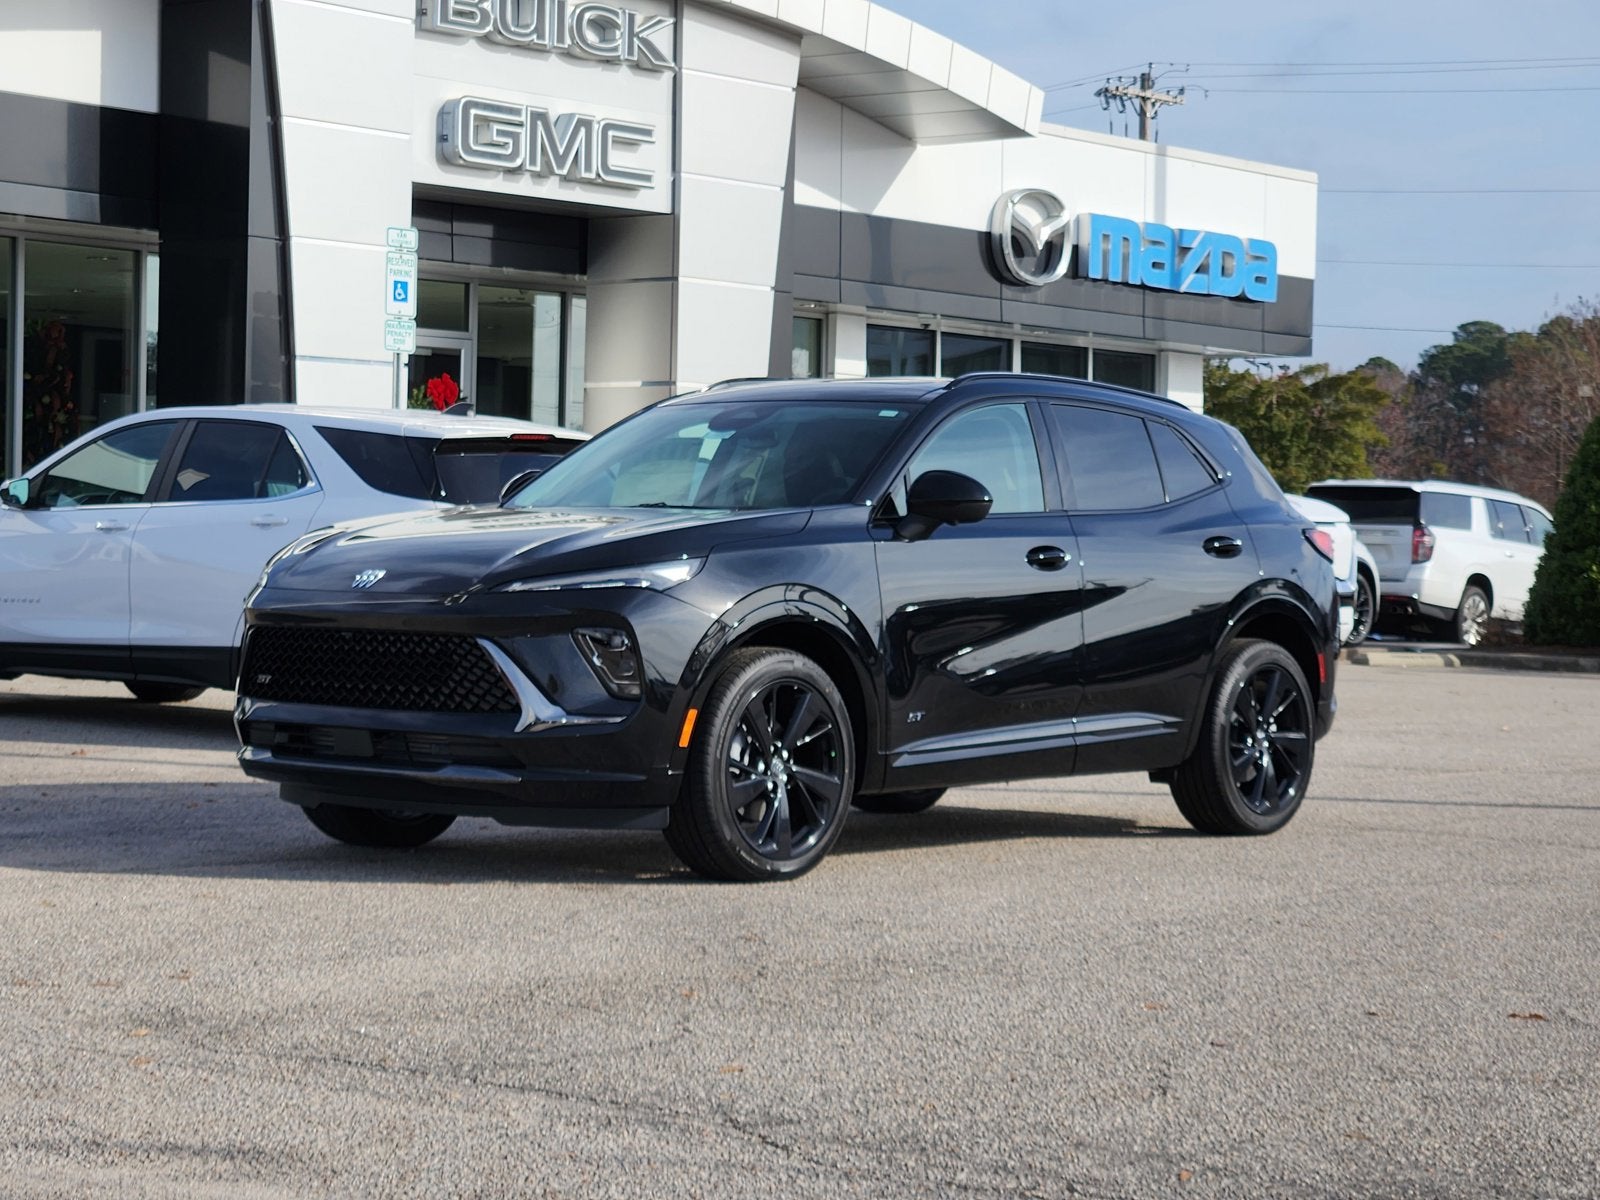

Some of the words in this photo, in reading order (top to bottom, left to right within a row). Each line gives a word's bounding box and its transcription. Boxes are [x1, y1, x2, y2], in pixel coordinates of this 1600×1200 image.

[422, 0, 677, 70] BUICK
[442, 95, 656, 189] GMC
[388, 256, 414, 267] RESERVED
[389, 268, 412, 278] PARKING
[1084, 212, 1278, 303] mazda
[387, 330, 412, 338] PENALTY
